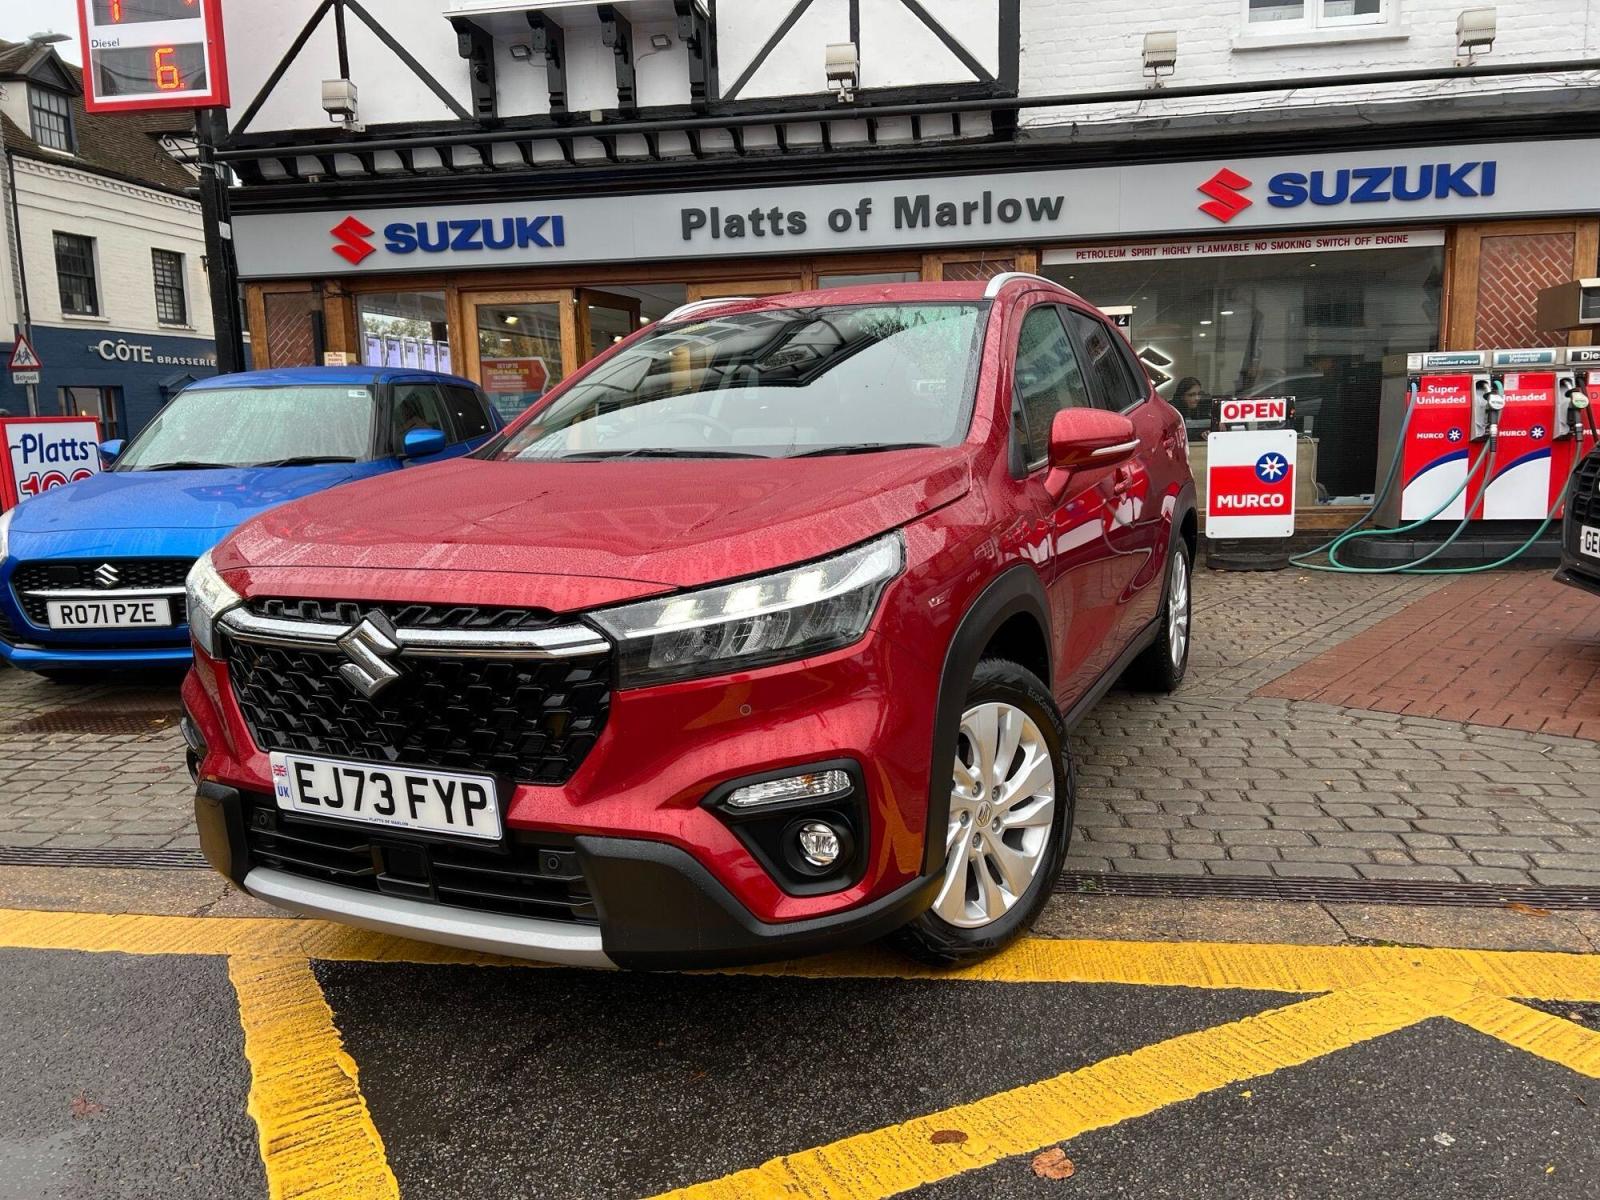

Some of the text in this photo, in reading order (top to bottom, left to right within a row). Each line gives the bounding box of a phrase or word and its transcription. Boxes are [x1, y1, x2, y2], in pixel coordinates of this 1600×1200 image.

[91, 37, 120, 48] Diesel
[1267, 160, 1497, 208] SUZUKI
[681, 190, 1065, 241] Platts of Marlow
[383, 215, 565, 255] SUZUKI
[1076, 234, 1409, 260] PETROLEUM SPIRIT HIGHLY FLAMMABLE NO SMOKING SWITCH OFF ENGINE
[1118, 314, 1125, 325] 2
[98, 339, 217, 367] CÔTE BRASSERIE
[1416, 396, 1467, 405] Unleaded
[1427, 385, 1459, 395] Super
[1223, 402, 1284, 420] OPEN
[21, 432, 89, 464] Platts
[1216, 493, 1284, 508] MURCO
[1585, 530, 1600, 553] GE
[113, 603, 157, 624] PZE
[277, 786, 290, 798] UK
[294, 762, 488, 827] EJ73 FYP
